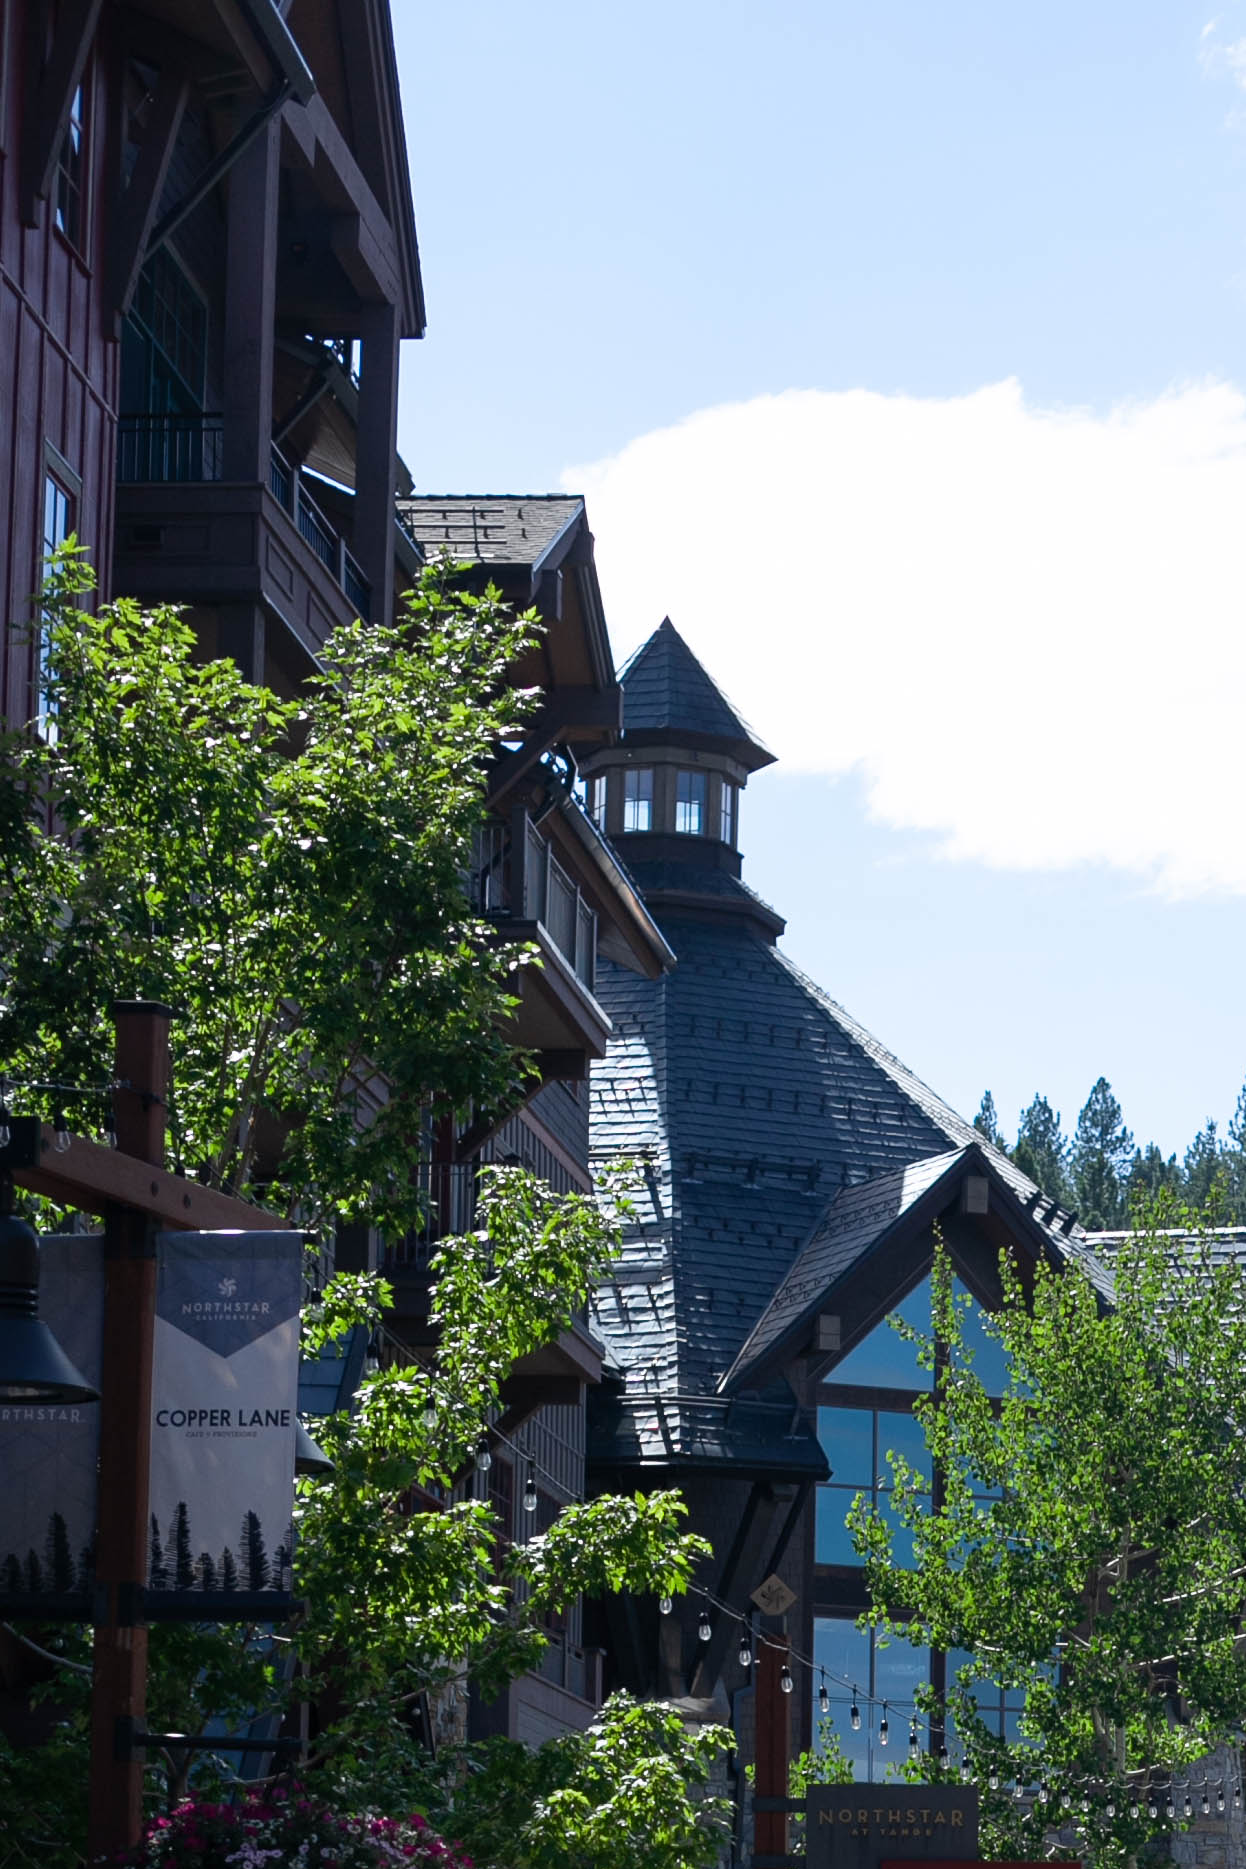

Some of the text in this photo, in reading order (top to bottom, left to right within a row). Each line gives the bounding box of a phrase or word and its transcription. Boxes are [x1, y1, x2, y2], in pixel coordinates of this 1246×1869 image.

[182, 1302, 270, 1314] NORTHSTAR
[156, 1409, 290, 1428] COPPER LANE
[818, 1808, 963, 1827] NORTHSTAR
[851, 1827, 933, 1837] AT TAHOE
